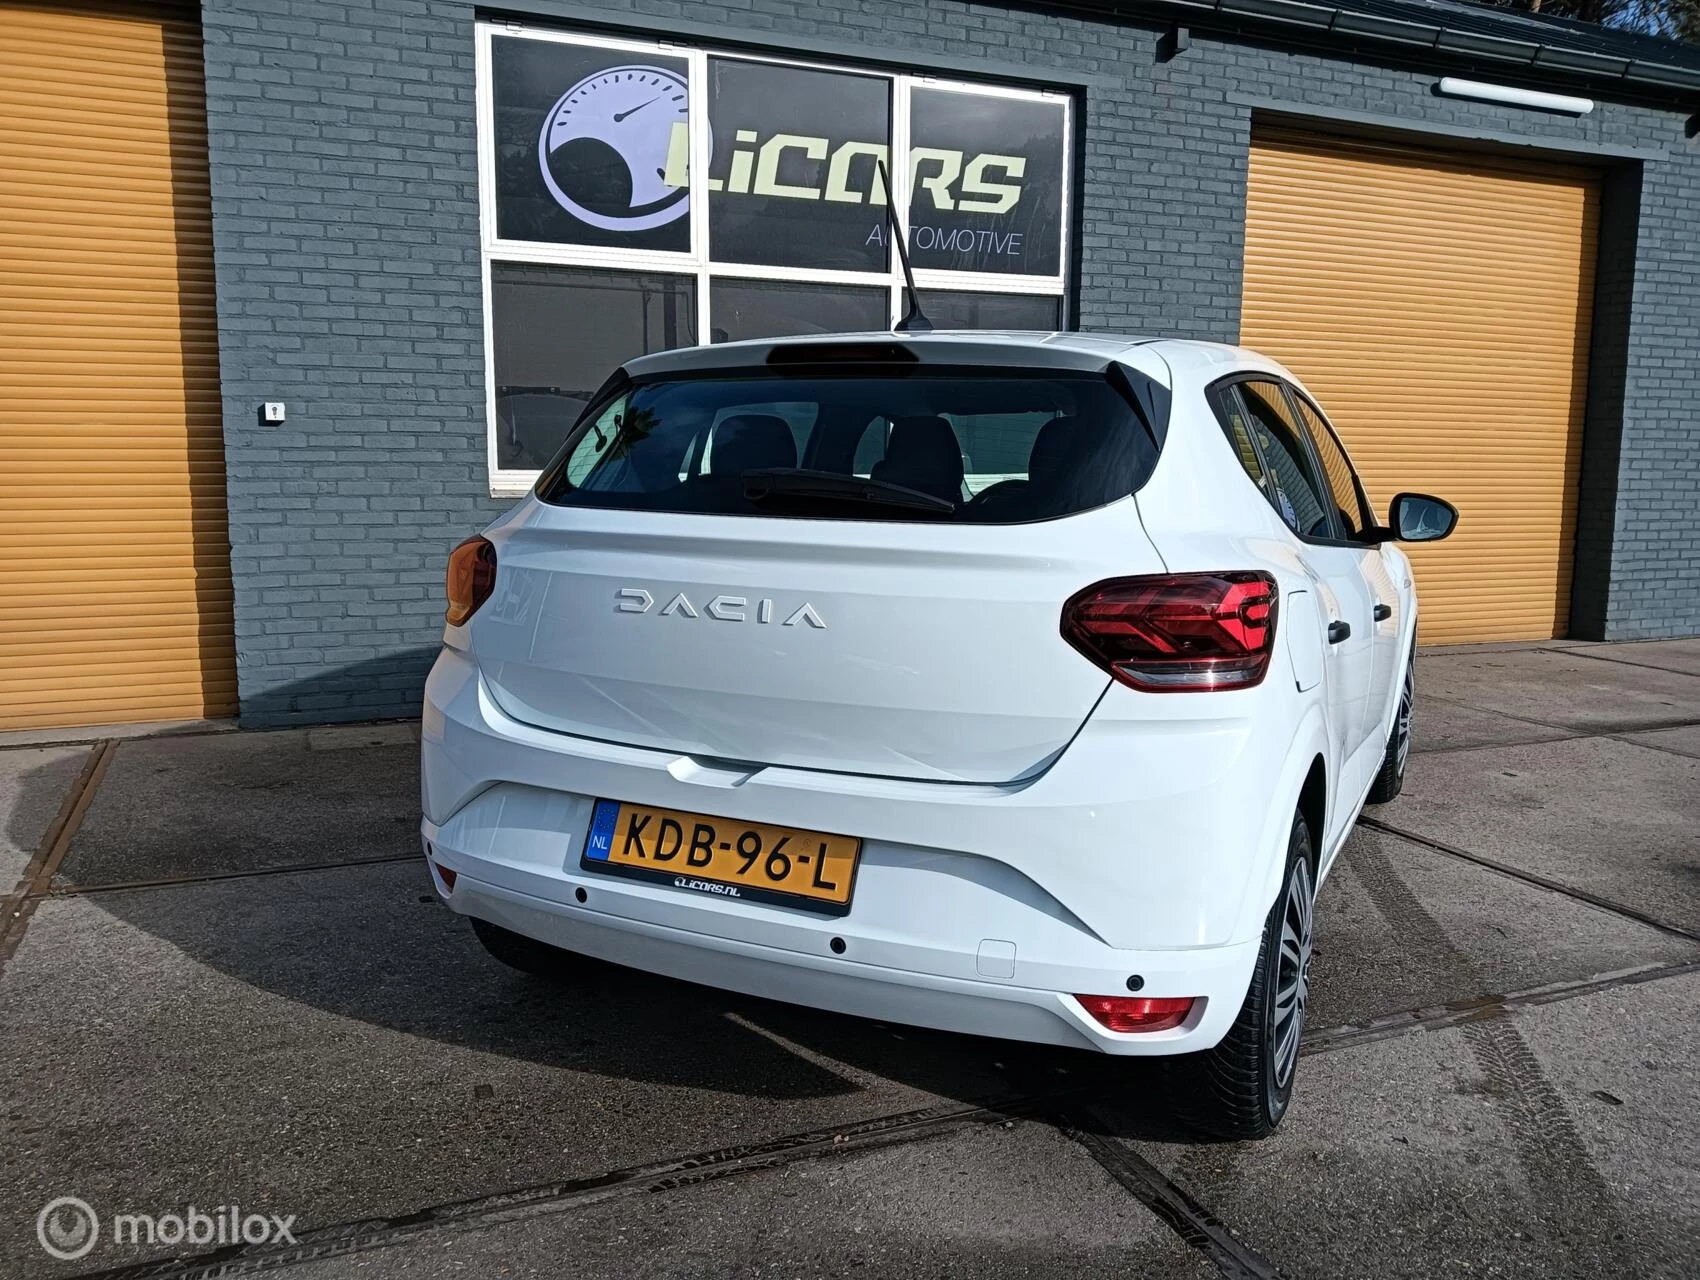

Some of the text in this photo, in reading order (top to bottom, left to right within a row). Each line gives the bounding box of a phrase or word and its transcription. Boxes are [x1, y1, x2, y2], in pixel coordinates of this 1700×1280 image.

[865, 223, 1024, 255] ATOMOTIVE
[615, 588, 828, 629] DACIA
[592, 835, 608, 850] NL
[622, 812, 838, 892] KDB-96-L
